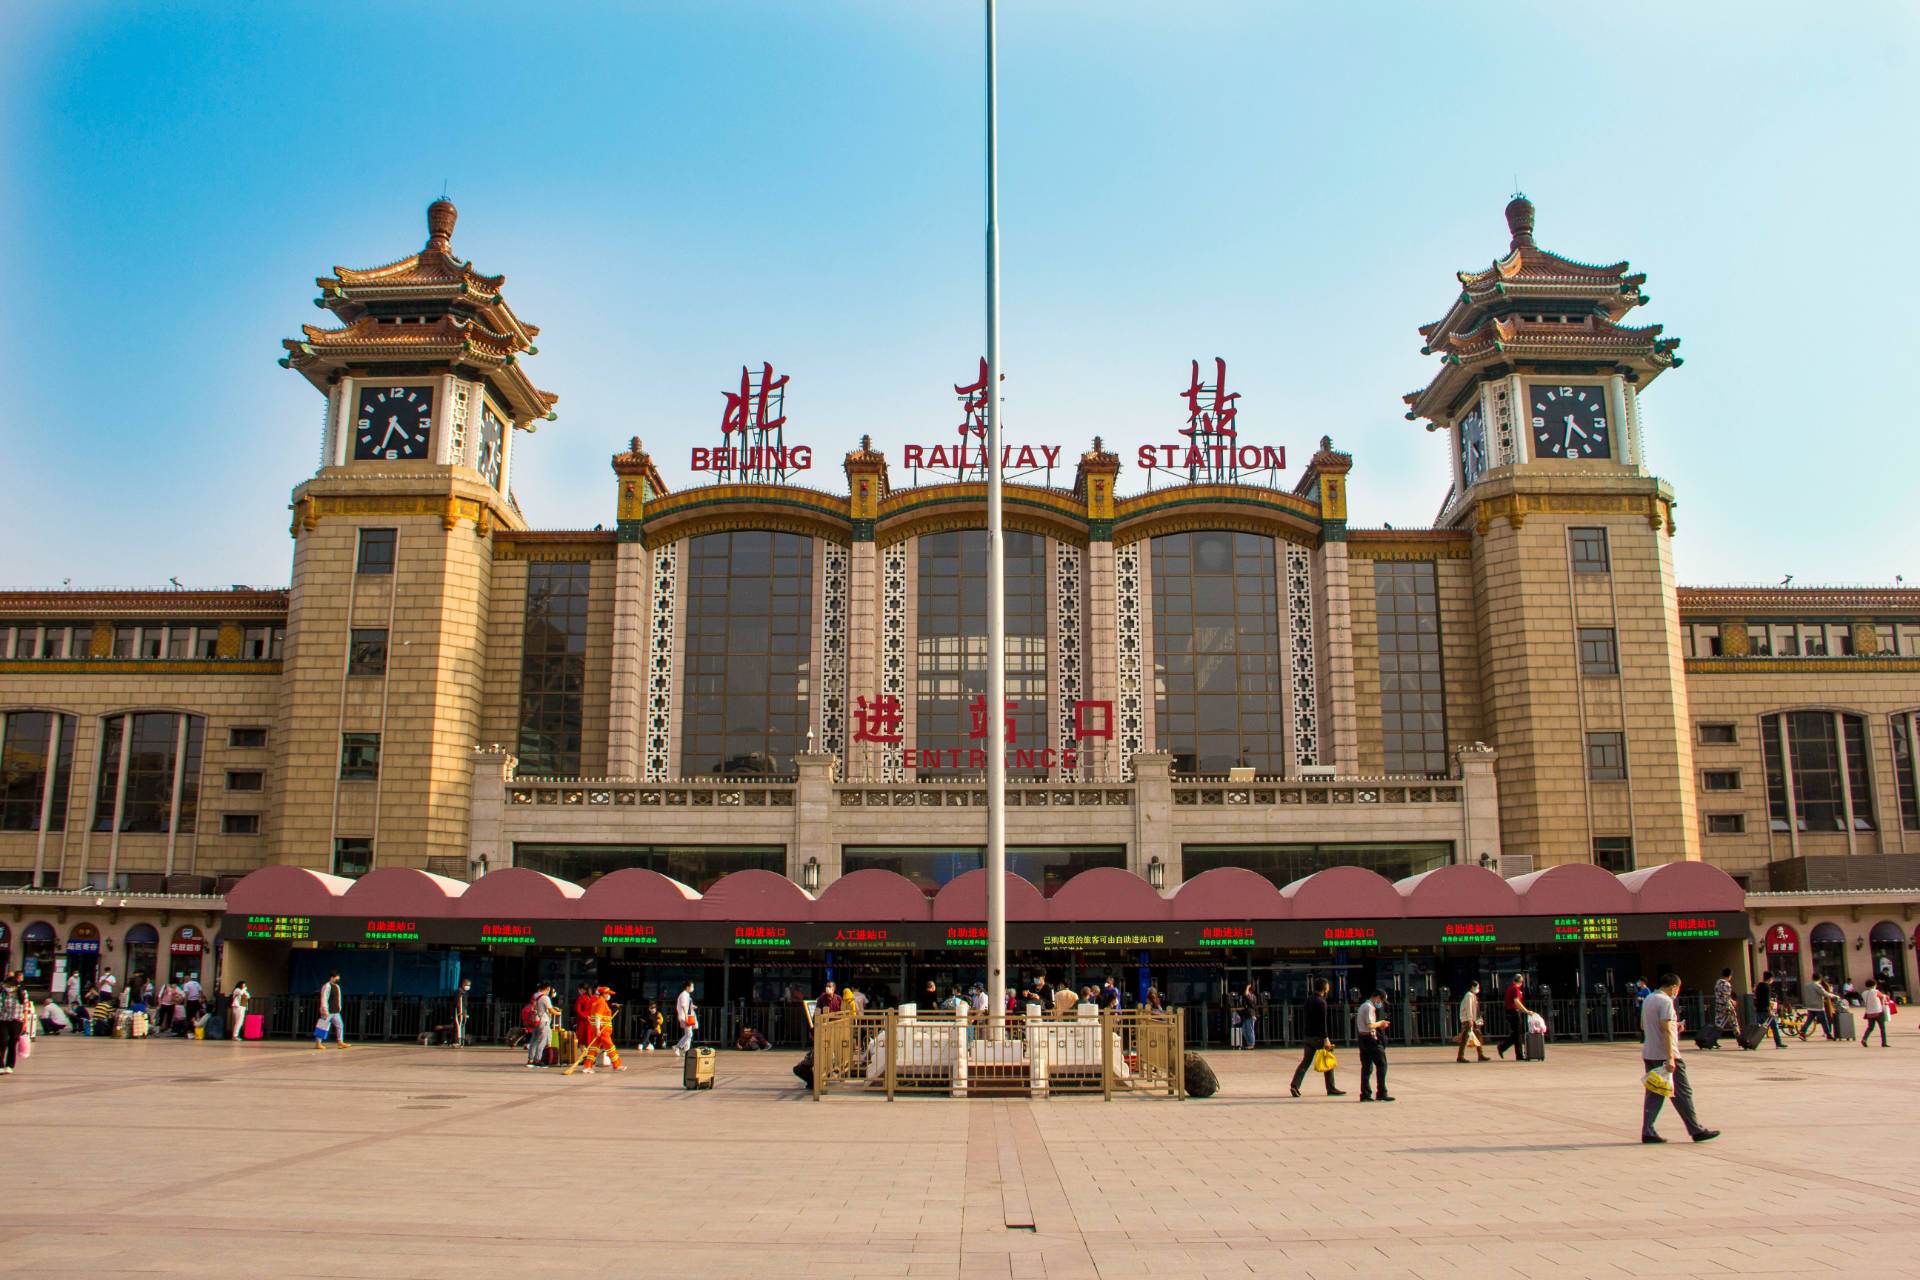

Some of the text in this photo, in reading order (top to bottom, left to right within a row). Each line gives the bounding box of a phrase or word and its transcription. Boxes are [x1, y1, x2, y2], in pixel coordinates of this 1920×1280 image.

[390, 387, 404, 398] 12
[1559, 387, 1573, 397] 12
[358, 418, 371, 430] 9
[418, 418, 431, 429] 3
[1532, 417, 1545, 427] 9
[1594, 418, 1606, 428] 3
[386, 449, 398, 460] 6
[691, 444, 1287, 471] BEIJING RAILWAY STATION
[1566, 448, 1579, 459] 6
[902, 748, 1077, 769] ENTRNCE
[367, 921, 416, 932] 自助进站口
[482, 924, 533, 936] 自助进站口
[604, 924, 654, 936] 自助进站口
[1445, 923, 1495, 935] 自助进站口
[1668, 919, 1716, 930] 自助进站口
[735, 926, 786, 938] 自助进站口
[835, 928, 888, 941] 人工进站口
[947, 927, 989, 938] 自助进站
[1203, 927, 1254, 939] 自助进站口
[1324, 927, 1375, 939] 自助进站口
